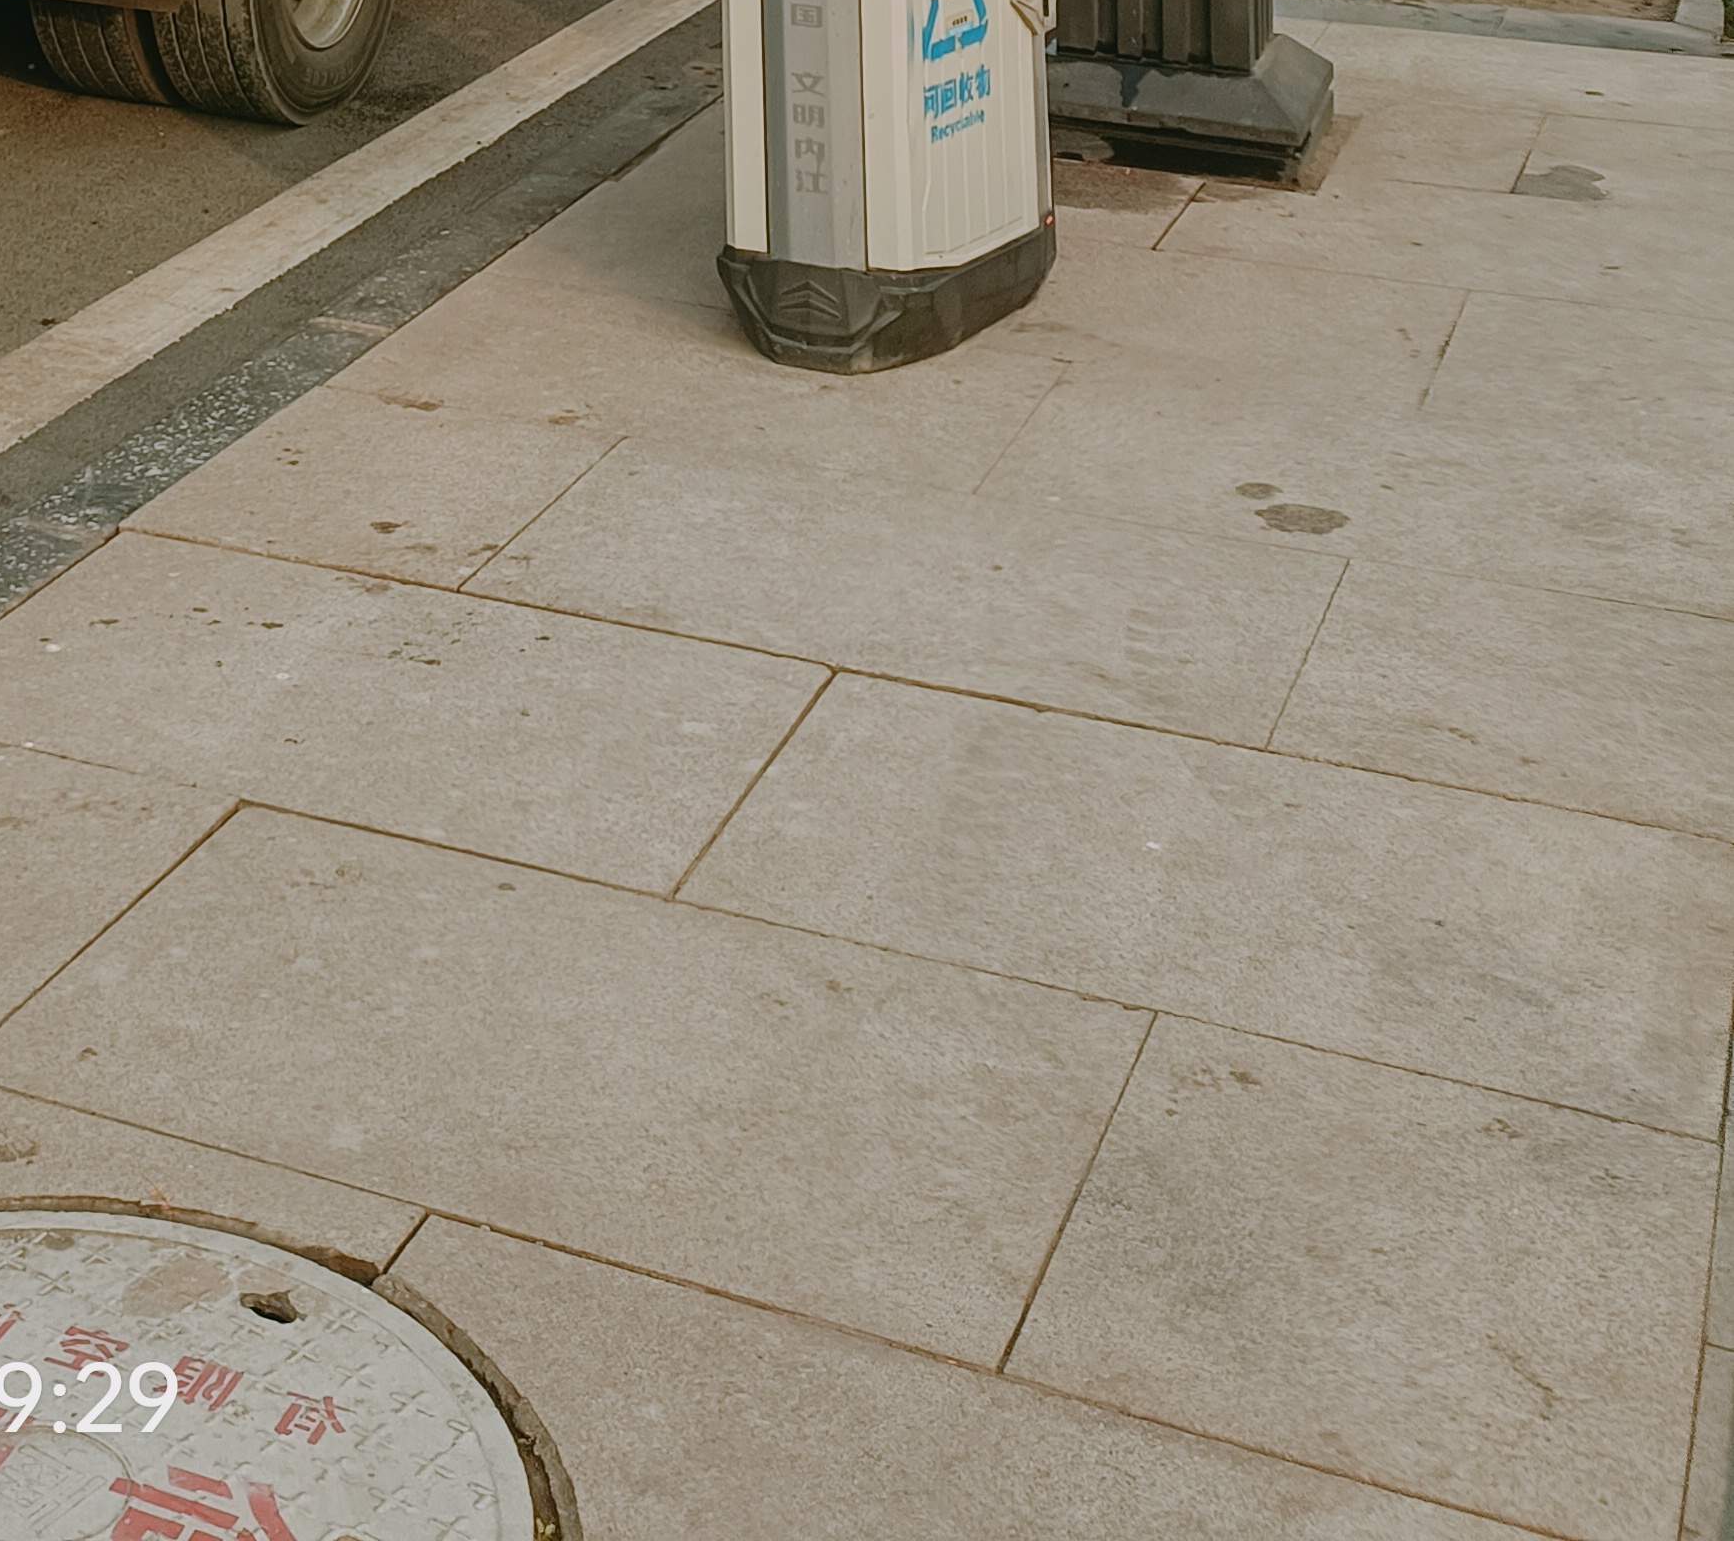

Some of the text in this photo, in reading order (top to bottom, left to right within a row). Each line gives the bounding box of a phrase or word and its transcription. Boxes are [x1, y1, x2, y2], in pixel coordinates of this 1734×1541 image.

[791, 71, 829, 196] 文明内江
[923, 64, 991, 122] 可回收物
